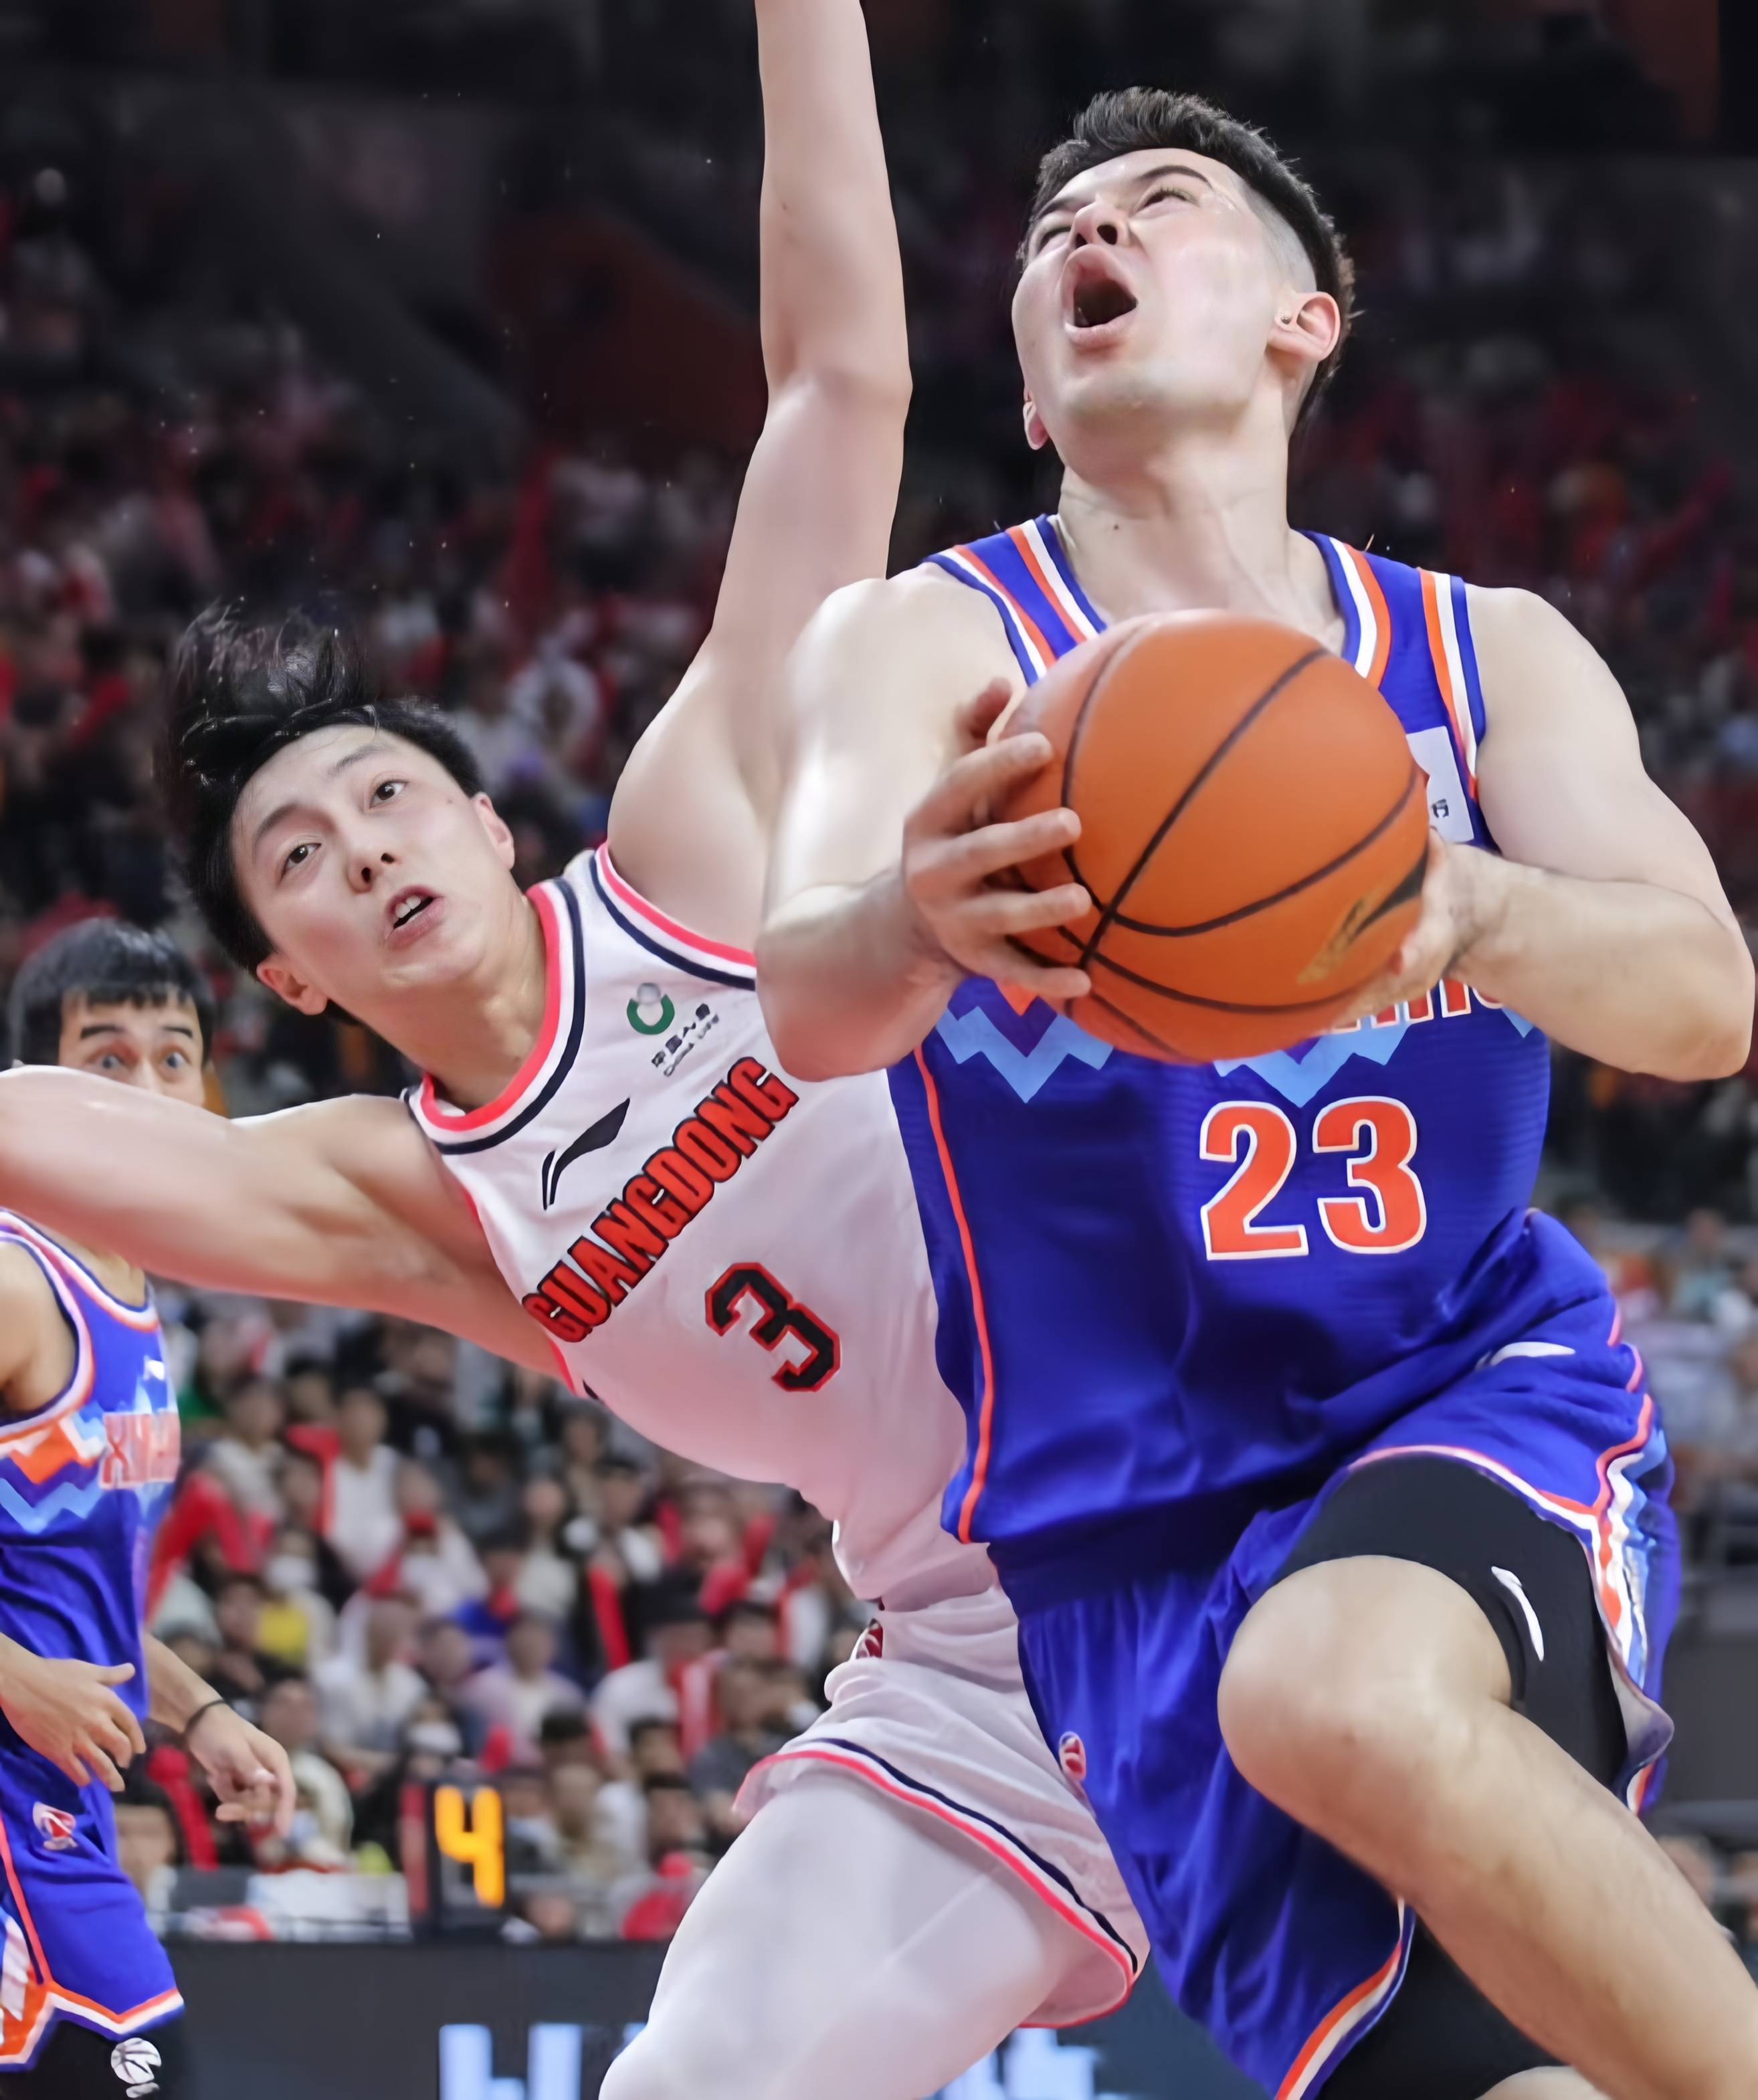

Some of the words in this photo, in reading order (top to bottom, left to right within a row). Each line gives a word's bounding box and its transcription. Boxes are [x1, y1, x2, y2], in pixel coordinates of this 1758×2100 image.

[521, 1056, 799, 1342] GUANGDONG
[1199, 1096, 1427, 1261] 23
[704, 1262, 841, 1392] 3
[434, 1784, 505, 1909] 4
